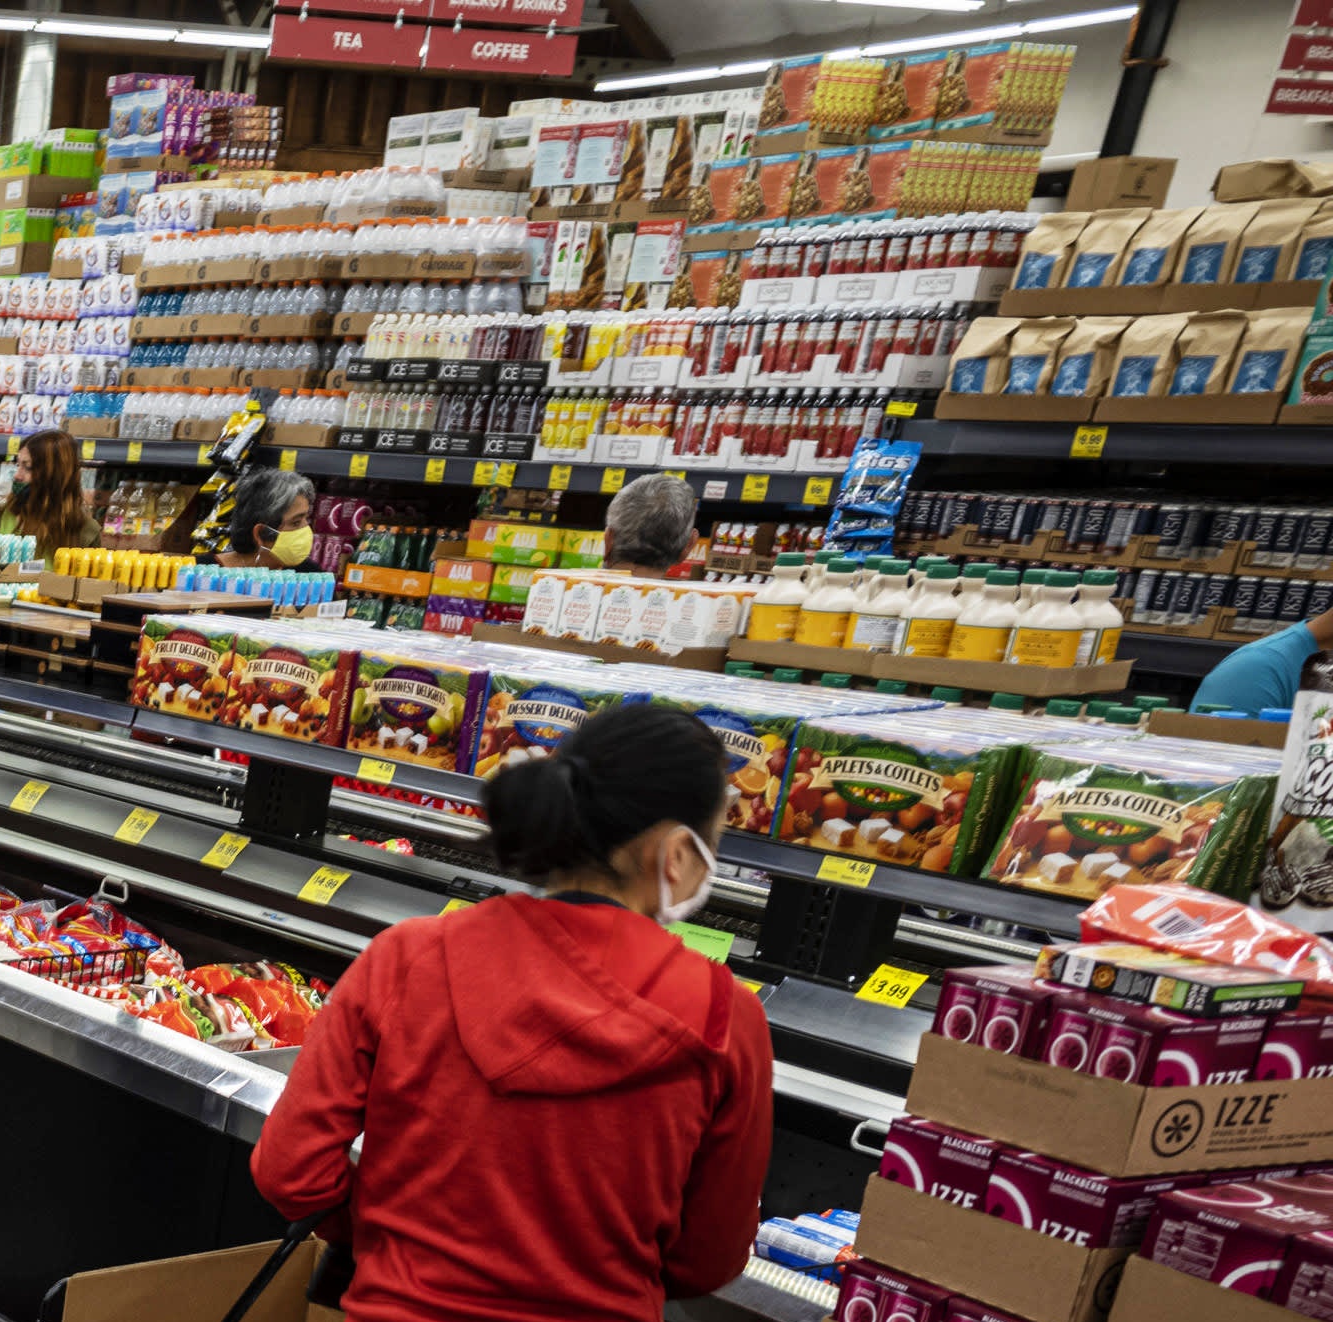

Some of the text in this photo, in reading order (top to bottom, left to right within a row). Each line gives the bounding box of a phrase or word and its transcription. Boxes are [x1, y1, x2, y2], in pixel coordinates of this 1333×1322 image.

[332, 31, 363, 50] TEA
[471, 40, 530, 61] COFFEE
[389, 362, 407, 376] ICE
[440, 363, 457, 378] ICE
[501, 366, 518, 380] ICE
[378, 431, 394, 446] ICE
[431, 436, 448, 451] ICE
[486, 438, 504, 454] ICE
[994, 503, 1015, 531] 1850
[1083, 508, 1105, 536] 1850
[511, 531, 538, 549] AHA
[1304, 519, 1330, 548] 1850
[448, 564, 473, 581] AHA
[1234, 584, 1257, 611] 1850
[1256, 586, 1282, 614] 1850
[1280, 587, 1307, 616] 1850
[155, 640, 218, 665] FRUIT DELIGHTS
[247, 661, 316, 684] FRUIT DELIGHTS
[373, 680, 447, 706] NORTHWEST DELIGHTS
[508, 702, 543, 718] DESSERT
[821, 758, 873, 775] APLETS
[884, 762, 942, 793] COTLETS
[1088, 1006, 1125, 1022] BLACKBERRY
[1220, 1019, 1267, 1032] BLACKBERRY
[1214, 1093, 1280, 1128] IZZE
[941, 1134, 993, 1157] BLACKBERRY
[1053, 1170, 1108, 1195] BLACKBERRY
[1197, 1210, 1241, 1230] BLACKBERRY
[874, 1274, 909, 1292] BLACKBERRY
